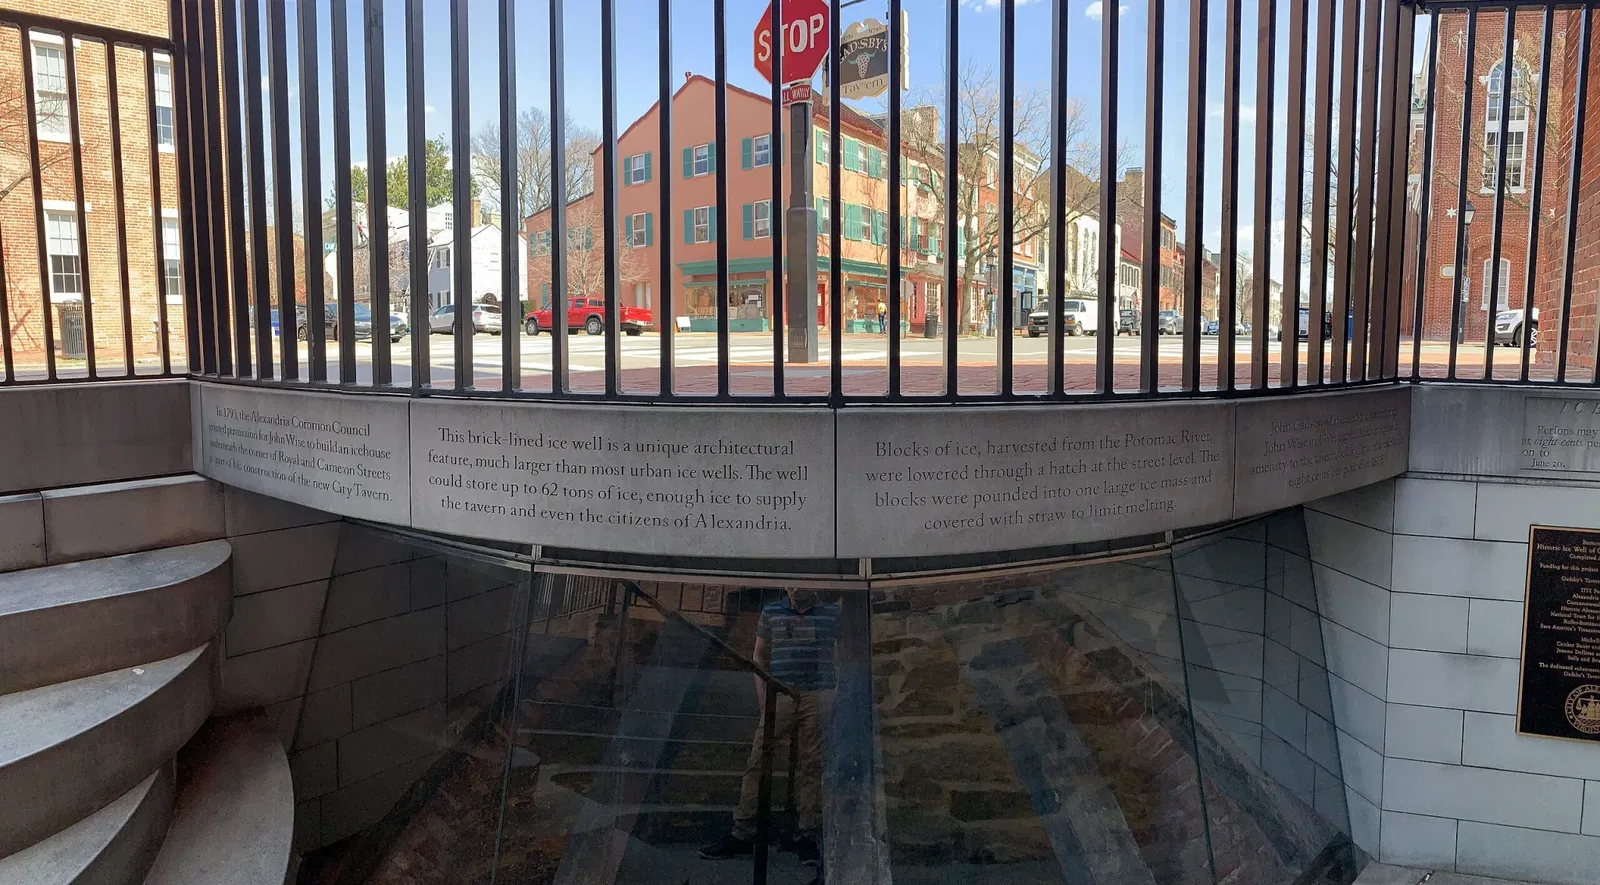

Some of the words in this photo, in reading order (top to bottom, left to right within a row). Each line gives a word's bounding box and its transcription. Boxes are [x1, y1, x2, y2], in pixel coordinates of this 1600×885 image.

[758, 13, 824, 62] STOP
[842, 78, 884, 95] Tavern
[216, 406, 222, 416] In
[239, 410, 250, 421] the
[250, 410, 290, 426] Alexandria
[292, 415, 331, 432] Common
[332, 421, 370, 436] Council
[1270, 421, 1291, 436] John
[1577, 428, 1598, 438] may
[227, 427, 258, 440] permission
[258, 430, 268, 441] for
[268, 431, 285, 444] John
[285, 434, 305, 448] Wise
[306, 440, 315, 450] to
[316, 440, 338, 454] build
[338, 446, 349, 455] an
[350, 445, 391, 460] icehouse
[438, 427, 465, 443] This
[468, 430, 543, 448] brick-lined
[548, 435, 568, 450] ice
[572, 436, 602, 451] well
[607, 437, 619, 452] is
[624, 442, 631, 452] a
[636, 440, 689, 458] unique
[694, 439, 794, 455] architectural
[875, 441, 929, 457] Blocks
[935, 440, 952, 456] of
[956, 442, 981, 457] ice,
[986, 437, 1057, 454] harvested
[1062, 436, 1095, 451] from
[1100, 436, 1120, 449] the
[1124, 433, 1178, 448] Potomac
[1180, 429, 1213, 443] River,
[1264, 441, 1285, 456] John
[1287, 438, 1308, 449] Wise
[1310, 438, 1317, 446] in
[1522, 437, 1531, 445] at
[1534, 436, 1558, 448] eight
[1561, 439, 1583, 447] cents
[1587, 440, 1600, 449] pe
[1540, 450, 1550, 458] to
[237, 444, 248, 455] the
[248, 449, 268, 459] corner
[270, 448, 278, 461] of
[278, 450, 299, 467] Royal
[300, 458, 315, 469] and
[317, 459, 355, 476] Cameron
[357, 464, 391, 481] Streets
[428, 449, 472, 469] feature,
[475, 454, 510, 469] much
[514, 456, 551, 476] larger
[556, 458, 587, 474] than
[591, 464, 626, 476] most
[630, 463, 672, 478] urban
[677, 464, 697, 479] ice
[702, 464, 743, 480] wells.
[745, 464, 772, 480] The
[776, 466, 808, 481] well
[865, 470, 903, 482] were
[907, 464, 968, 482] lowered
[974, 462, 1033, 481] through
[1037, 467, 1044, 476] a
[1050, 459, 1087, 475] hatch
[1091, 460, 1103, 472] at
[1107, 457, 1128, 472] the
[1131, 455, 1166, 470] street
[1169, 451, 1197, 466] level.
[1200, 450, 1220, 463] The
[1250, 460, 1288, 476] amenity
[1289, 459, 1299, 469] to
[1300, 456, 1312, 467] the
[1531, 458, 1550, 467] June
[215, 456, 225, 466] part
[226, 458, 233, 468] of
[233, 458, 242, 470] his
[243, 463, 286, 481] construction
[288, 472, 298, 482] of
[298, 474, 311, 487] the
[313, 480, 330, 491] new
[332, 480, 352, 499] City
[353, 483, 392, 502] Tavern.
[429, 474, 462, 488] could
[466, 478, 498, 491] store
[502, 483, 519, 497] up
[524, 483, 537, 494] to
[541, 482, 558, 497] 62
[563, 486, 593, 499] tons
[598, 485, 614, 500] of
[617, 486, 643, 504] ice,
[646, 488, 704, 508] enough
[710, 491, 731, 504] ice
[736, 492, 751, 505] to
[756, 491, 807, 510] supply
[875, 492, 927, 507] blocks
[932, 493, 968, 505] were
[973, 485, 1038, 508] pounded
[1043, 486, 1071, 499] into
[1075, 485, 1100, 496] one
[1103, 480, 1136, 496] large
[1140, 478, 1157, 490] ice
[1160, 477, 1188, 488] mass
[1191, 470, 1212, 485] and
[1289, 472, 1311, 488] eight
[441, 496, 461, 510] the
[465, 501, 506, 515] tavern
[510, 503, 536, 518] and
[541, 510, 574, 521] even
[579, 508, 604, 524] the
[608, 511, 669, 527] citizens
[674, 513, 693, 528] of
[694, 513, 792, 531] Alexandria.
[924, 513, 985, 530] covered
[989, 510, 1023, 526] with
[1028, 510, 1068, 523] straw
[1072, 509, 1084, 519] to
[1088, 503, 1122, 518] limit
[1126, 498, 1177, 515] melting.
